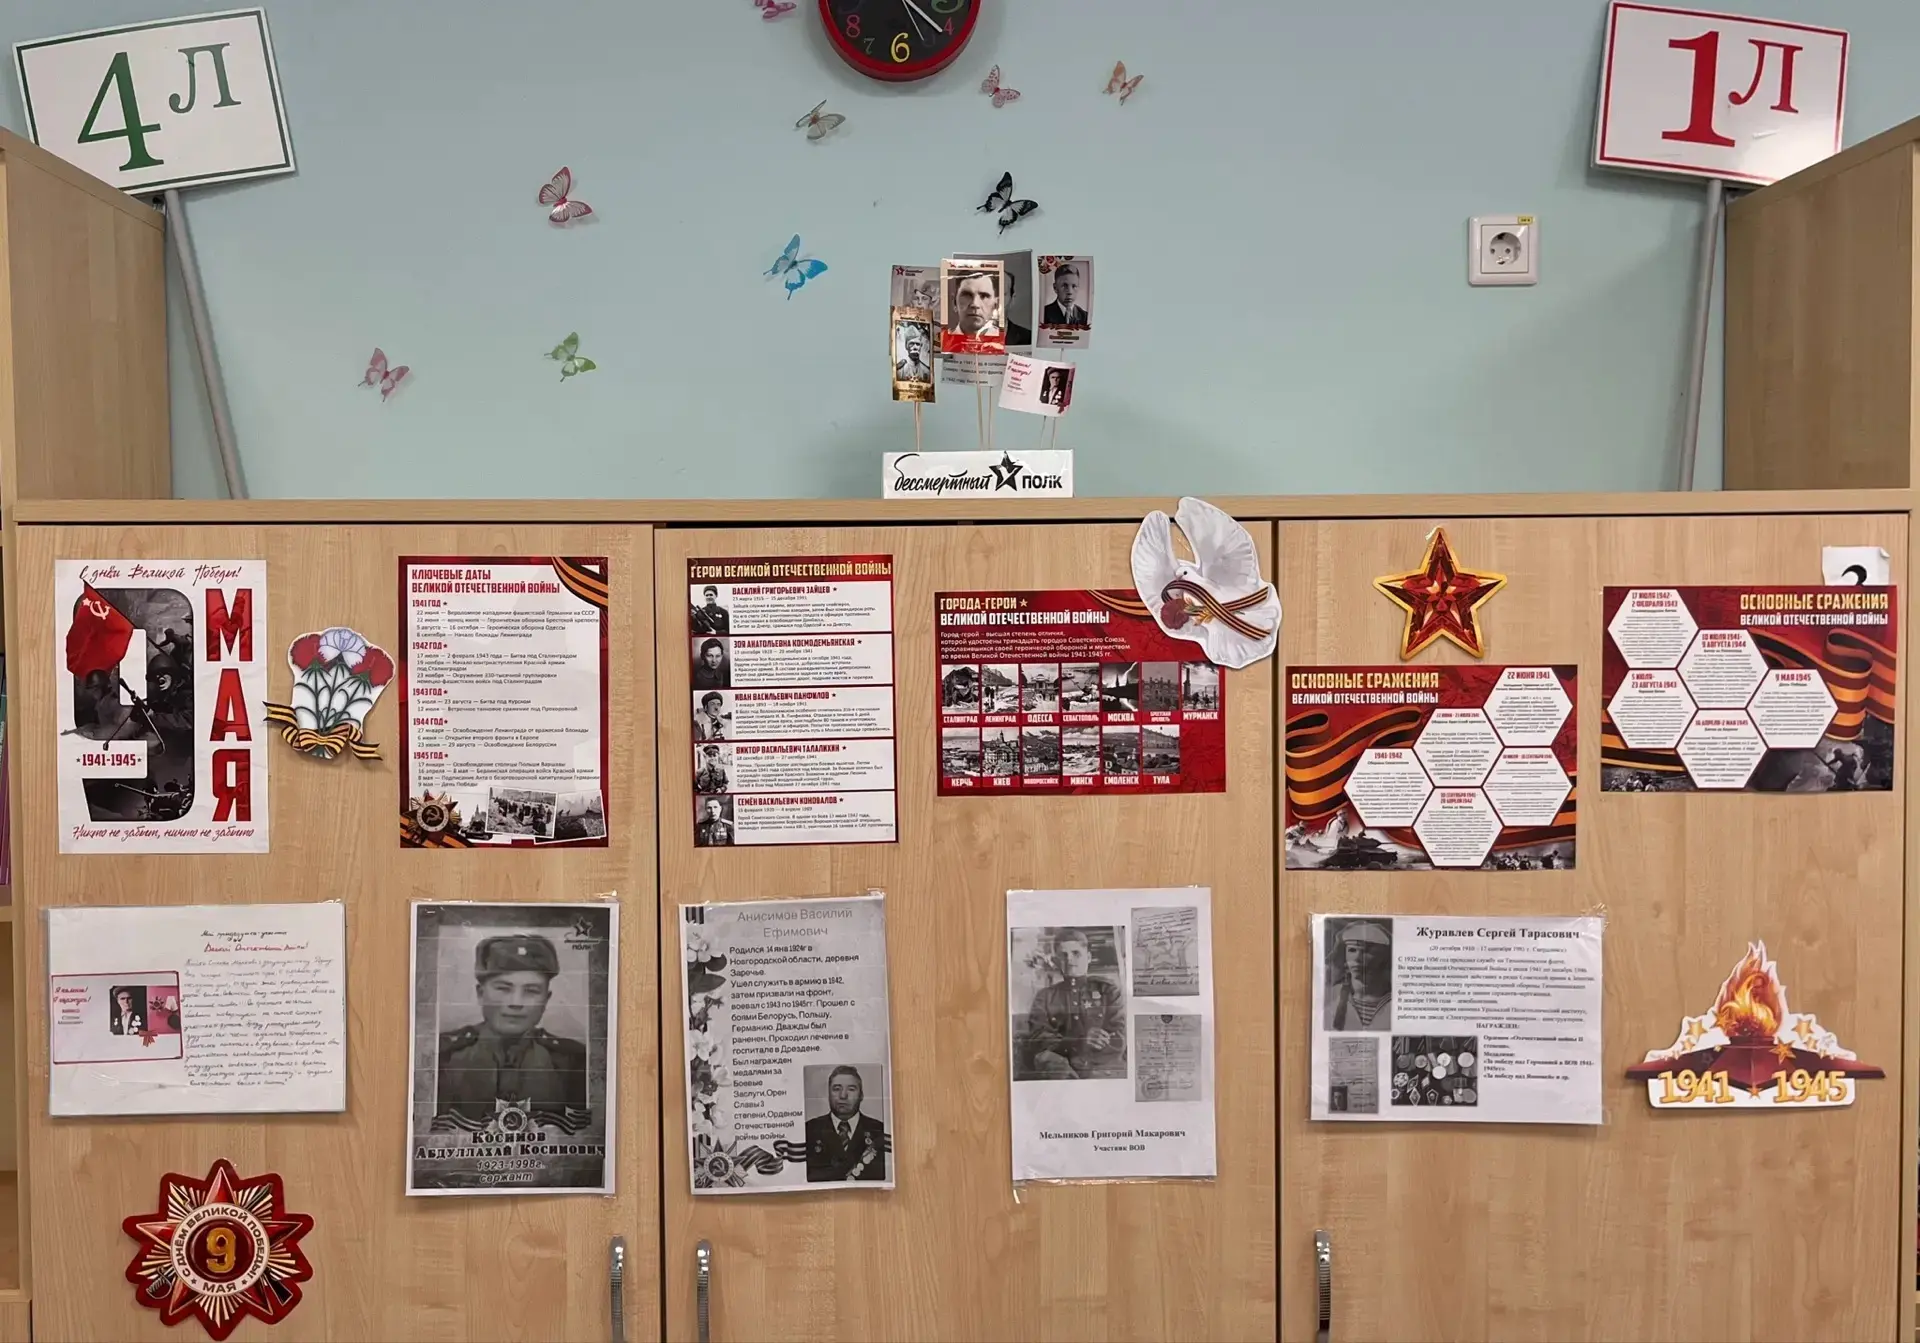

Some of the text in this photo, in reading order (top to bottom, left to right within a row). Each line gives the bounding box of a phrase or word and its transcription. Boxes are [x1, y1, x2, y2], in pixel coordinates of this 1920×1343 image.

[846, 14, 861, 38] 8
[943, 17, 954, 35] 4
[863, 37, 875, 54] 7
[891, 32, 910, 63] 6
[894, 453, 1063, 496] бессмертный ПОЛК
[128, 564, 185, 579] Великой
[192, 565, 242, 586] Победы!
[412, 569, 491, 581] КЛЮЧЕВЫЕ ДАТЫ
[691, 560, 891, 578] ГЕРОИ ВЕЛИКОЙ ОТЕЧЕСТВЕННОЙ ВОЙНЫ
[412, 581, 560, 593] ВЕЛИКОЙ ОТЕЧЕСТВЕННОЙ ВОЙНЫ
[732, 585, 830, 595] ВАСИЛИЙ ГРИГОРЬЕВИЧ ЗАЙЦЕВ
[428, 600, 441, 608] ГОД
[940, 597, 1017, 610] ГОРОДА-ГЕРОИ
[1740, 594, 1889, 610] ОСНОВНЫЕ СРАЖЕНИЯ
[940, 609, 1109, 626] ВЕЛИКОЙ ОТЕЧЕСТВЕННОЙ ВОЙНЫ
[1740, 612, 1888, 626] ВЕЛИКОЙ ОТЕЧЕСТВЕННОЙ ВОЙНЫ
[412, 642, 442, 650] 1942 ГОД
[747, 640, 791, 648] АНАТОЛЬЕВНА
[793, 638, 855, 648] КОСМОДЕМЬЯНСКАЯ
[1291, 672, 1439, 689] ОСНОВНЫЕ СРАЖЕНИЯ
[412, 688, 443, 696] 1943 ГОД
[735, 691, 830, 701] ИВАН ВАСИЛЬЕВИЧ ПАНФИЛОВ
[1292, 691, 1439, 704] ВЕЛИКОЙ ОТЕЧЕСТВЕННОЙ ВОЙНЫ
[73, 588, 196, 822] 9
[204, 588, 253, 822] МАЯ
[413, 717, 444, 726] 1944 ГОД
[1027, 714, 1054, 723] ОДЕССА
[1107, 713, 1135, 722] МОСКВА
[1183, 711, 1218, 720] МУРМАНСК
[736, 744, 840, 754] ВИКТОР ВАСИЛЬЕВИЧ ТАЛАЛИХИН
[82, 752, 137, 767] 1941-1945
[413, 752, 444, 760] 1945 ГОД
[951, 778, 974, 787] КЕРЧЬ
[993, 777, 1011, 786] КИЕВ
[1070, 776, 1093, 785] МИНСК
[1104, 776, 1139, 785] СМОЛЕНСК
[1153, 775, 1170, 785] ТУЛА
[738, 796, 837, 806] СЕМЁН ВАСИЛЬЕВИЧ КОНОВАЛОВ
[72, 826, 255, 842] Никто не забыт, ничто не забыто
[737, 908, 853, 922] Анисимов Василий
[763, 927, 828, 940] Ефимович
[1416, 927, 1580, 940] Журавлев Сергей Тарасович
[756, 991, 794, 999] призвали
[731, 1013, 757, 1021] боями
[776, 1022, 810, 1032] Дважды
[811, 1022, 827, 1030] был
[750, 1057, 792, 1066] награжден
[1658, 1069, 1734, 1105] 1941
[1771, 1068, 1848, 1105] 1945
[1039, 1129, 1186, 1140] Мельников Григорий Макарович
[1093, 1144, 1146, 1152] Участник ВОВ
[479, 1173, 533, 1184] сержант
[174, 1207, 266, 1280] С ДНЁМ ВЕЛИКОЙ ПОБЕДЫ!
[206, 1227, 237, 1274] 9
[202, 1282, 237, 1294] МАЯ
